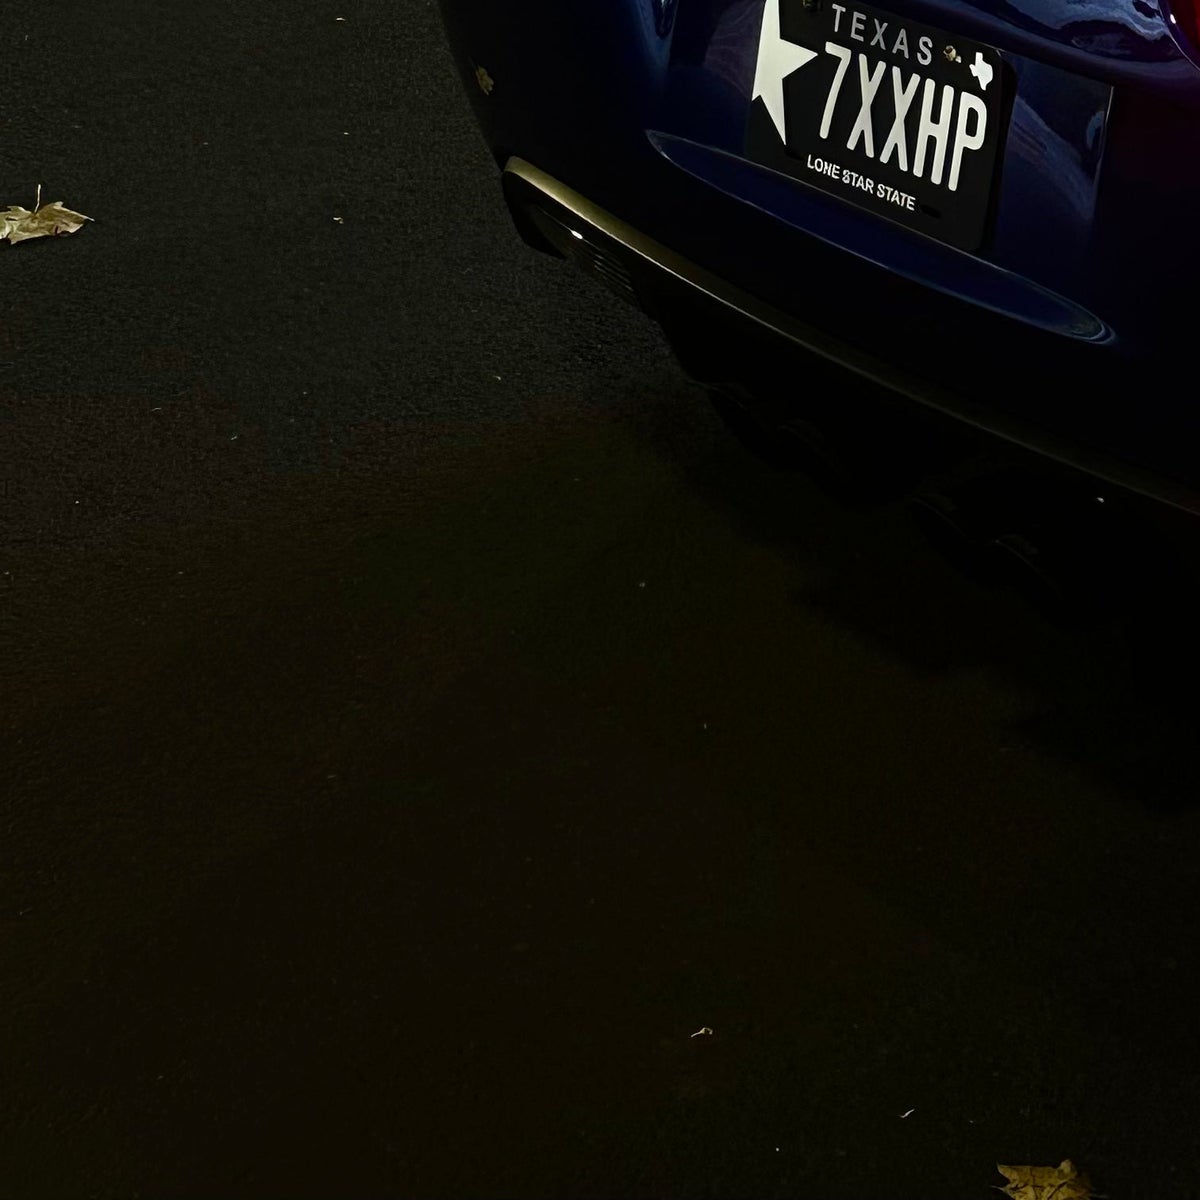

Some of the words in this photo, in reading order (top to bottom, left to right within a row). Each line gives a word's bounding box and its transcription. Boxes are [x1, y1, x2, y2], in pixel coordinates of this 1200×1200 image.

[832, 3, 933, 66] TEXAS
[819, 41, 988, 192] 7XXHP
[807, 154, 840, 180] LONE
[843, 169, 874, 195] STAR
[877, 183, 916, 211] STATE
